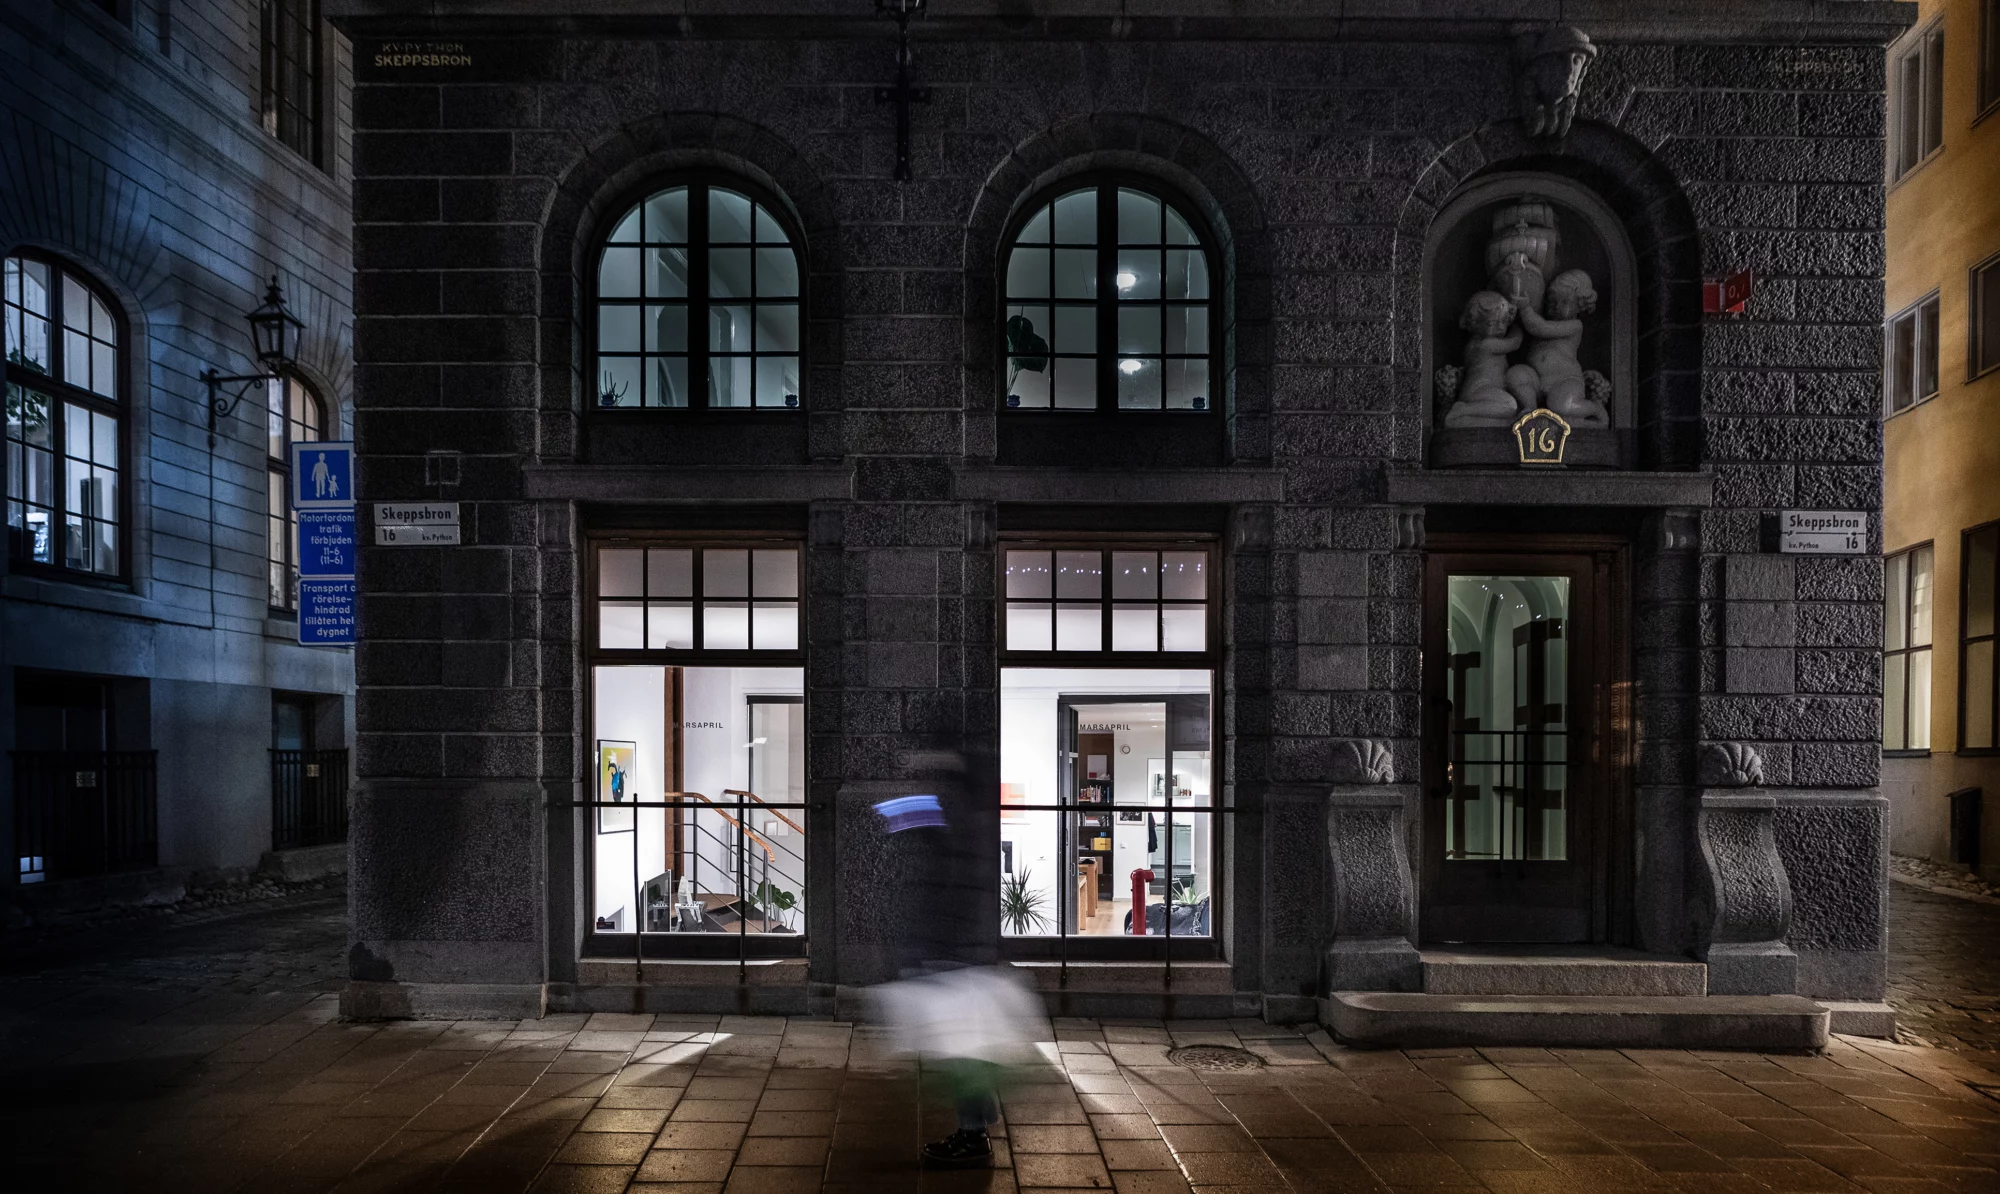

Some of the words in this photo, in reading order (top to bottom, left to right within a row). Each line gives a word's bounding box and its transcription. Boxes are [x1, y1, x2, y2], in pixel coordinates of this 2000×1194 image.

[374, 54, 472, 67] SKEPPSBRON
[1528, 427, 1555, 453] 16
[382, 506, 451, 522] Skeppsbron
[1789, 514, 1859, 530] Skeppsbron
[319, 525, 342, 533] trafik
[310, 535, 352, 546] förbjuden
[382, 529, 396, 541] 16
[432, 534, 452, 542] Python
[1799, 542, 1819, 550] Python
[1845, 537, 1859, 549] 16
[302, 584, 348, 594] Transport
[312, 595, 352, 603] rörelse-
[314, 606, 351, 614] hindrad
[305, 616, 337, 625] tillåten
[340, 616, 355, 624] hel
[317, 627, 349, 638] dygnet
[673, 721, 723, 729] MRSAPRIL
[1079, 723, 1131, 731] MARSAPRIL
